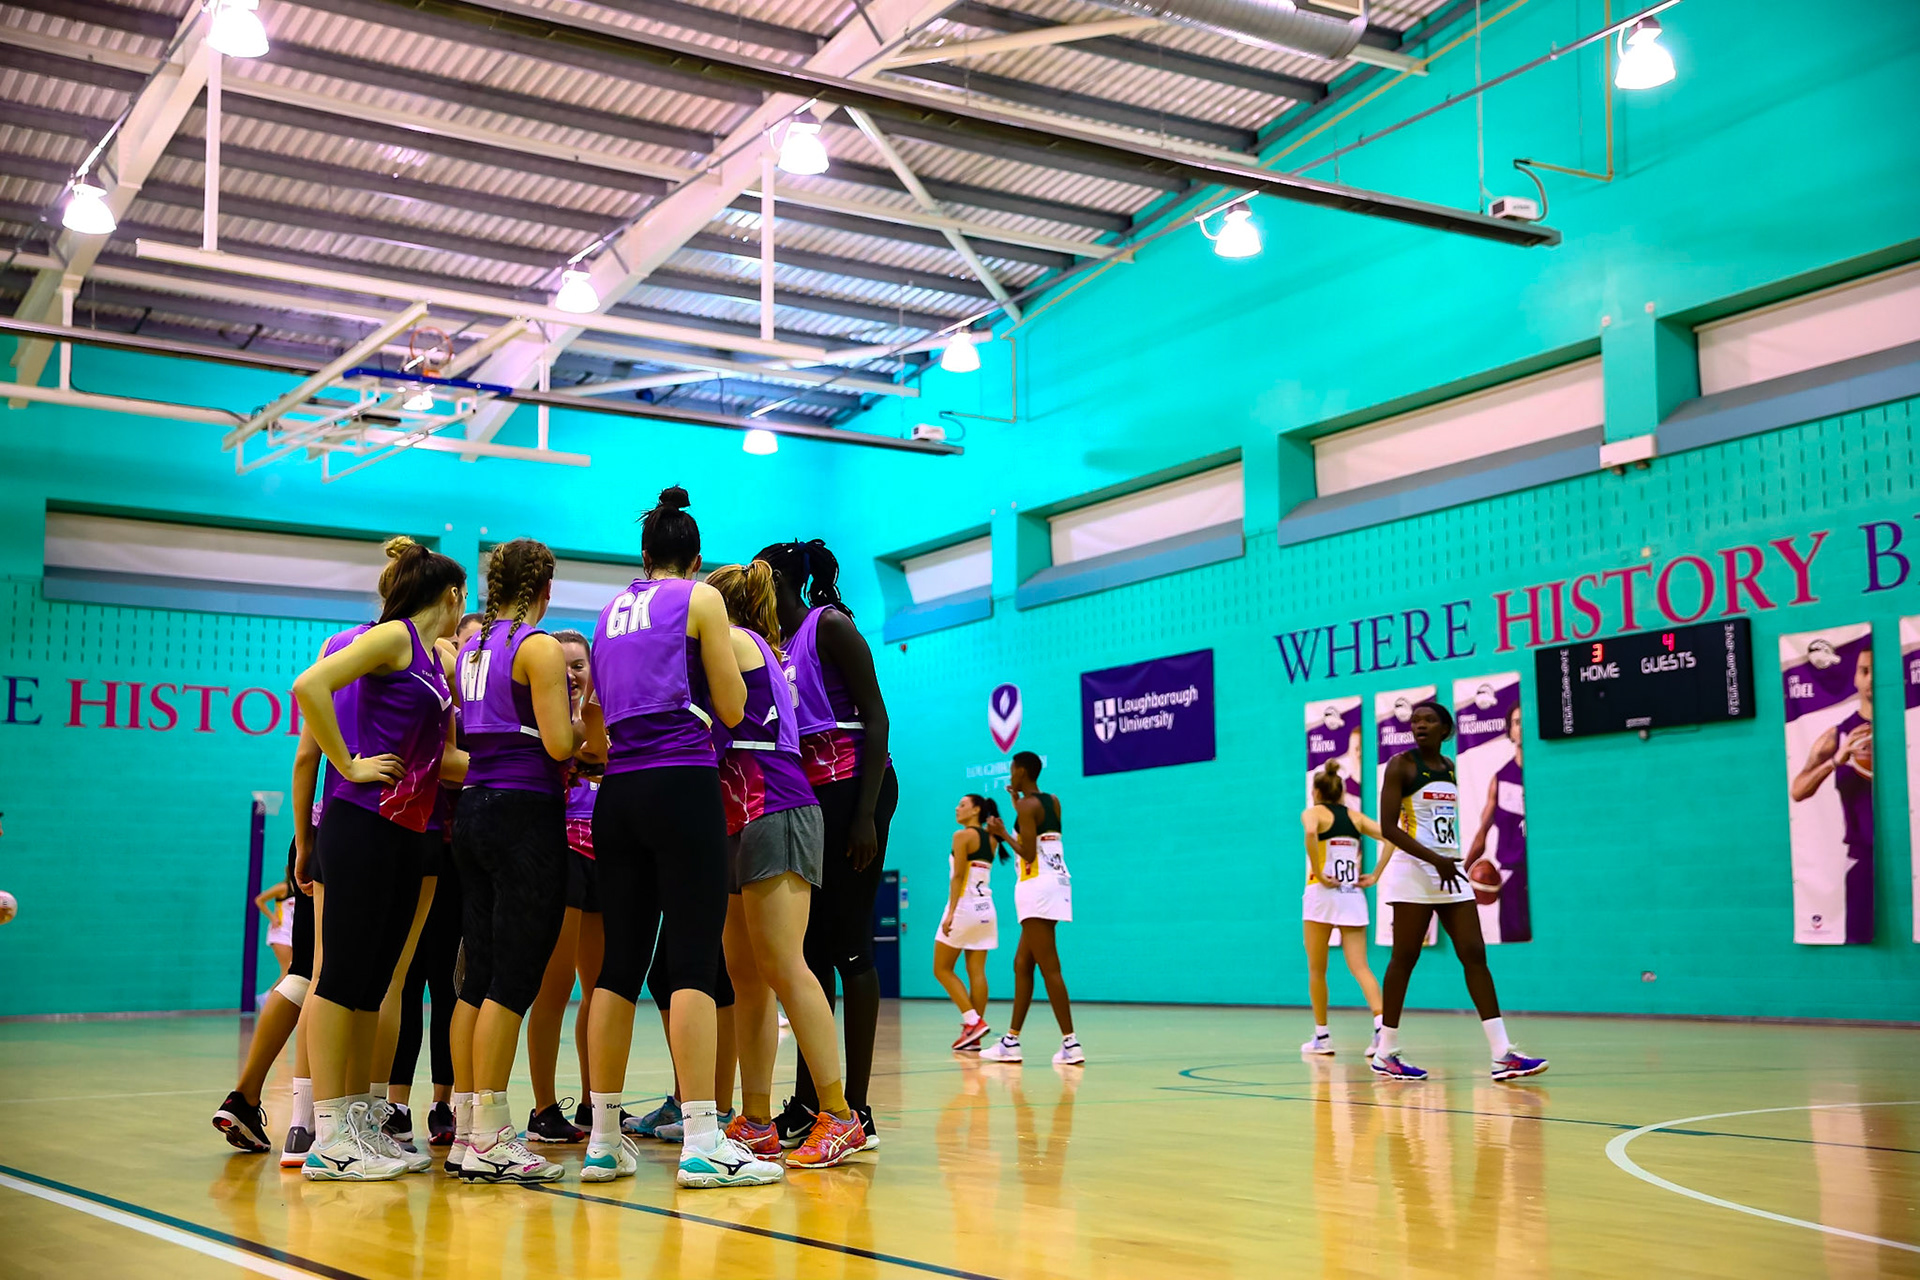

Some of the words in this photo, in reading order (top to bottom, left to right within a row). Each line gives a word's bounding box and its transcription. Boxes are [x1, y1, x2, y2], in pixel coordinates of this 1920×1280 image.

[1275, 599, 1476, 685] WHERE
[1492, 530, 1830, 654] HISTORY
[1858, 513, 1920, 594] B
[606, 584, 661, 639] GK
[1592, 643, 1604, 663] 3
[1662, 632, 1676, 652] 4
[1580, 661, 1621, 682] HOME
[1640, 651, 1697, 674] GUESTS
[1117, 684, 1199, 715] Loughborough
[1118, 709, 1175, 734] University
[1335, 859, 1355, 882] GD
